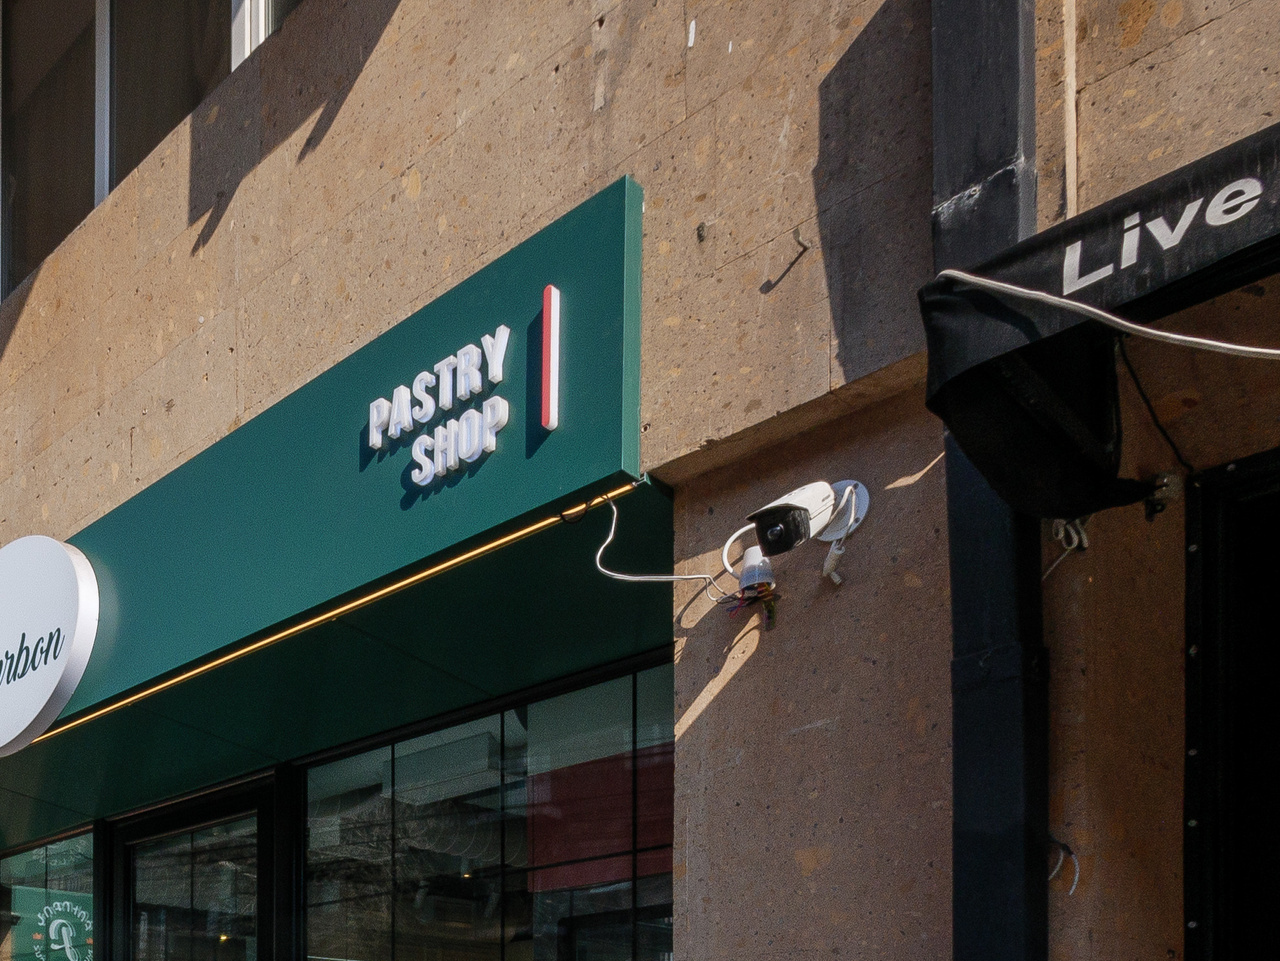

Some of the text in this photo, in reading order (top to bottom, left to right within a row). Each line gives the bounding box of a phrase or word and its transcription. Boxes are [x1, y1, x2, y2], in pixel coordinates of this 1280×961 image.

[1062, 176, 1264, 297] Live
[368, 324, 511, 449] PASTRY
[411, 395, 510, 487] SHOP
